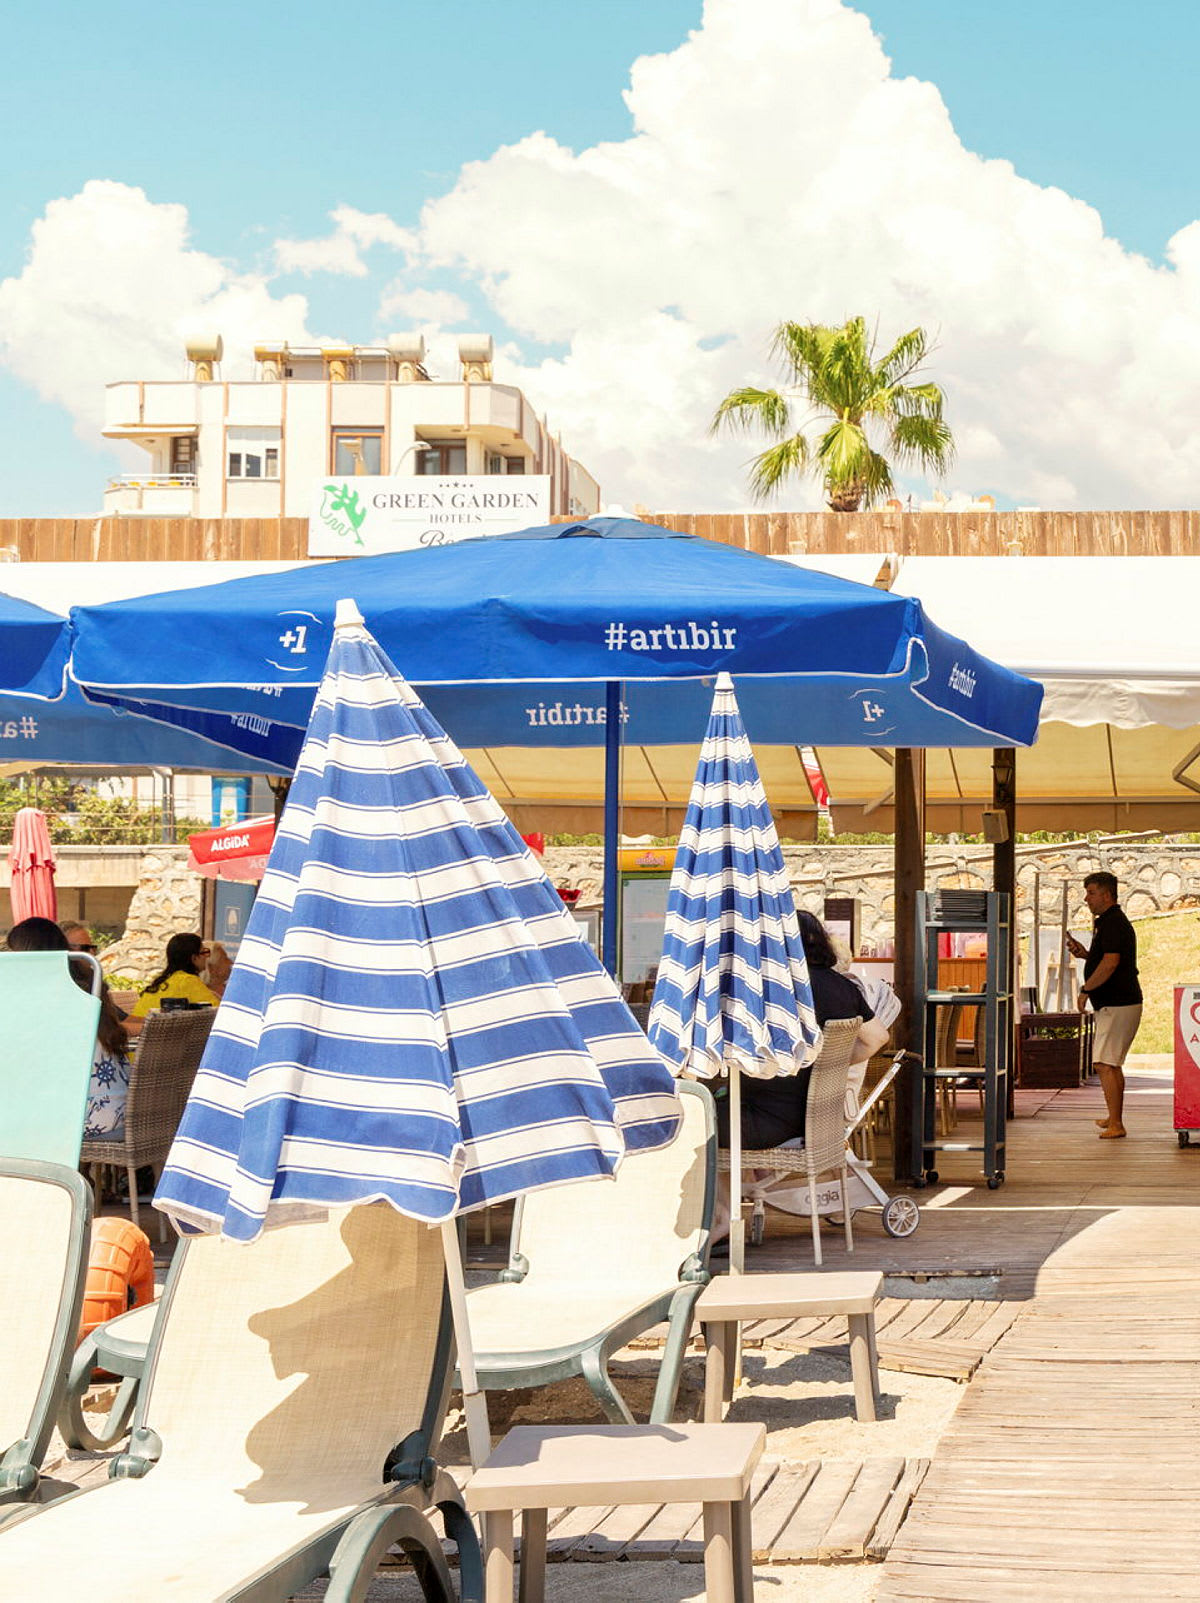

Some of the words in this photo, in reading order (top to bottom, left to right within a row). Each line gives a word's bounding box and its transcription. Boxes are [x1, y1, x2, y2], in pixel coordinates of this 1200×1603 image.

[372, 493, 443, 509] GREEN
[451, 493, 539, 509] GARDEN
[429, 513, 482, 524] HOTELS
[279, 626, 307, 653] +1
